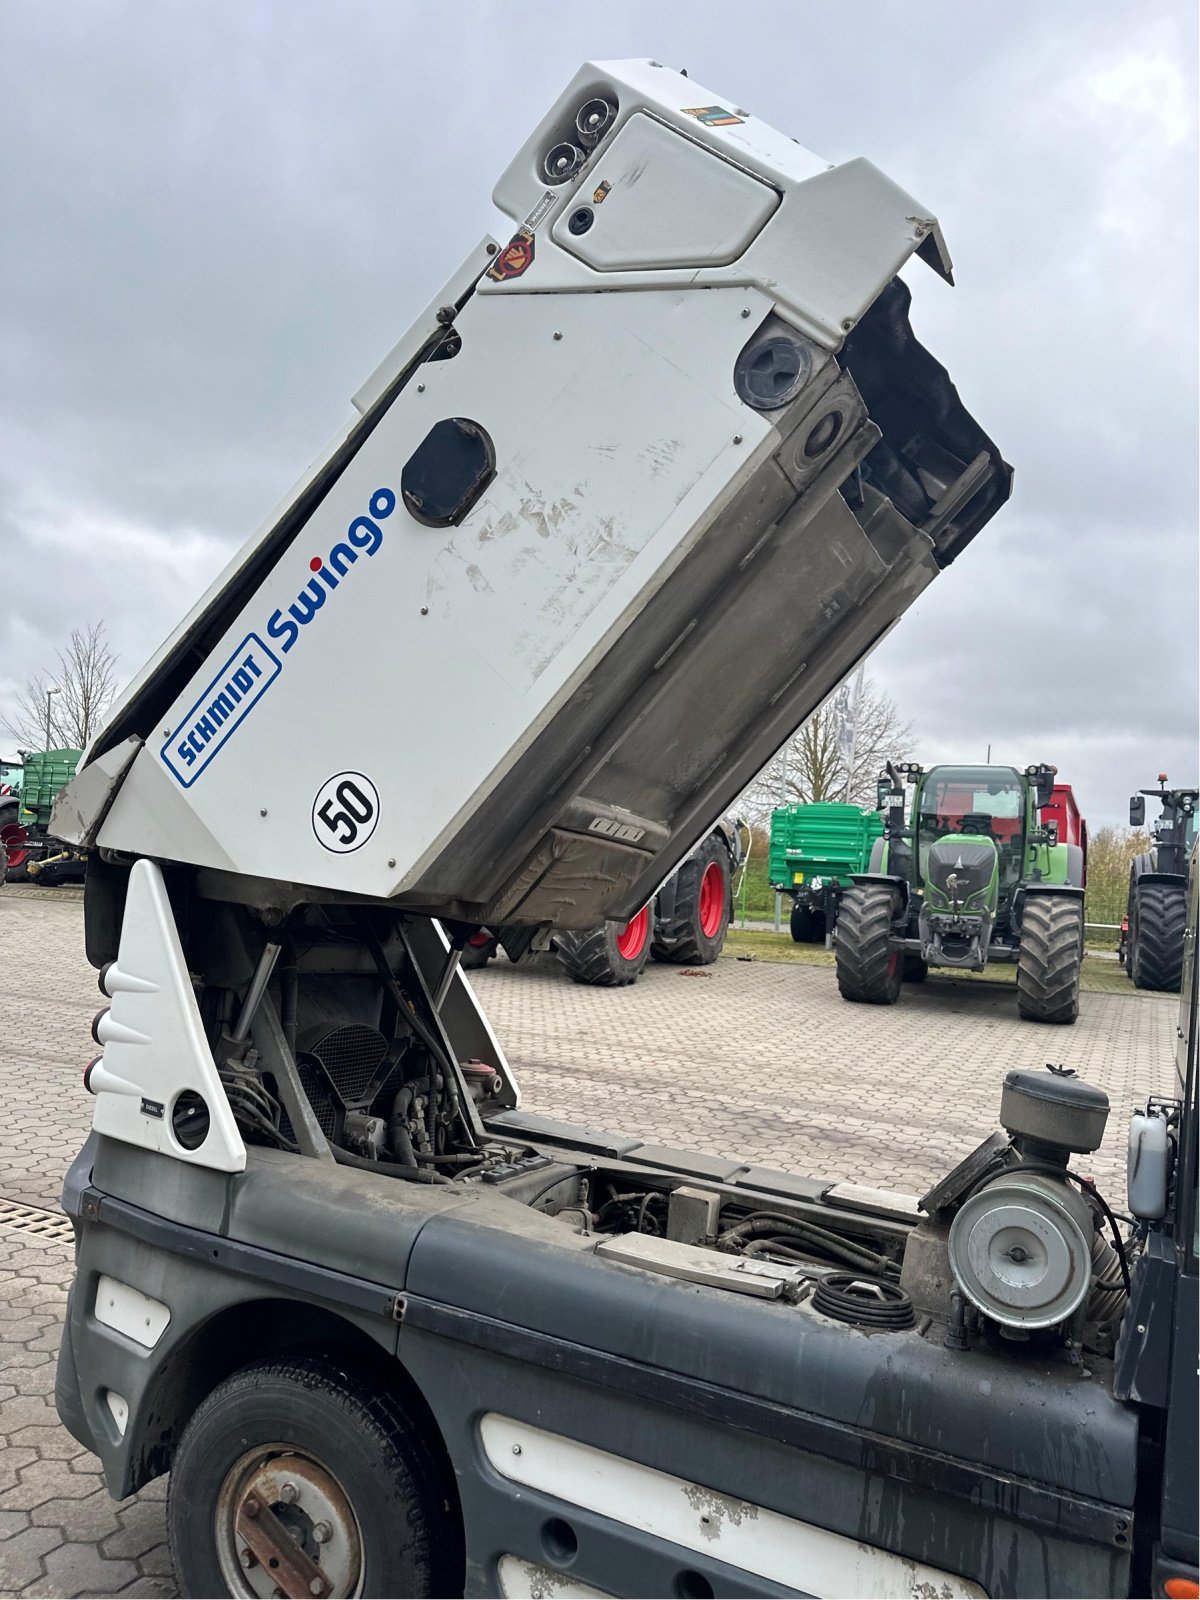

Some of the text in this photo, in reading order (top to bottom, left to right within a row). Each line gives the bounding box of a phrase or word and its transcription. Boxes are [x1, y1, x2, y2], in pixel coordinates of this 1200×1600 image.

[530, 198, 550, 222] WASSER
[267, 487, 396, 654] Swingo
[177, 654, 263, 767] SCHMIDT
[317, 780, 374, 845] 50
